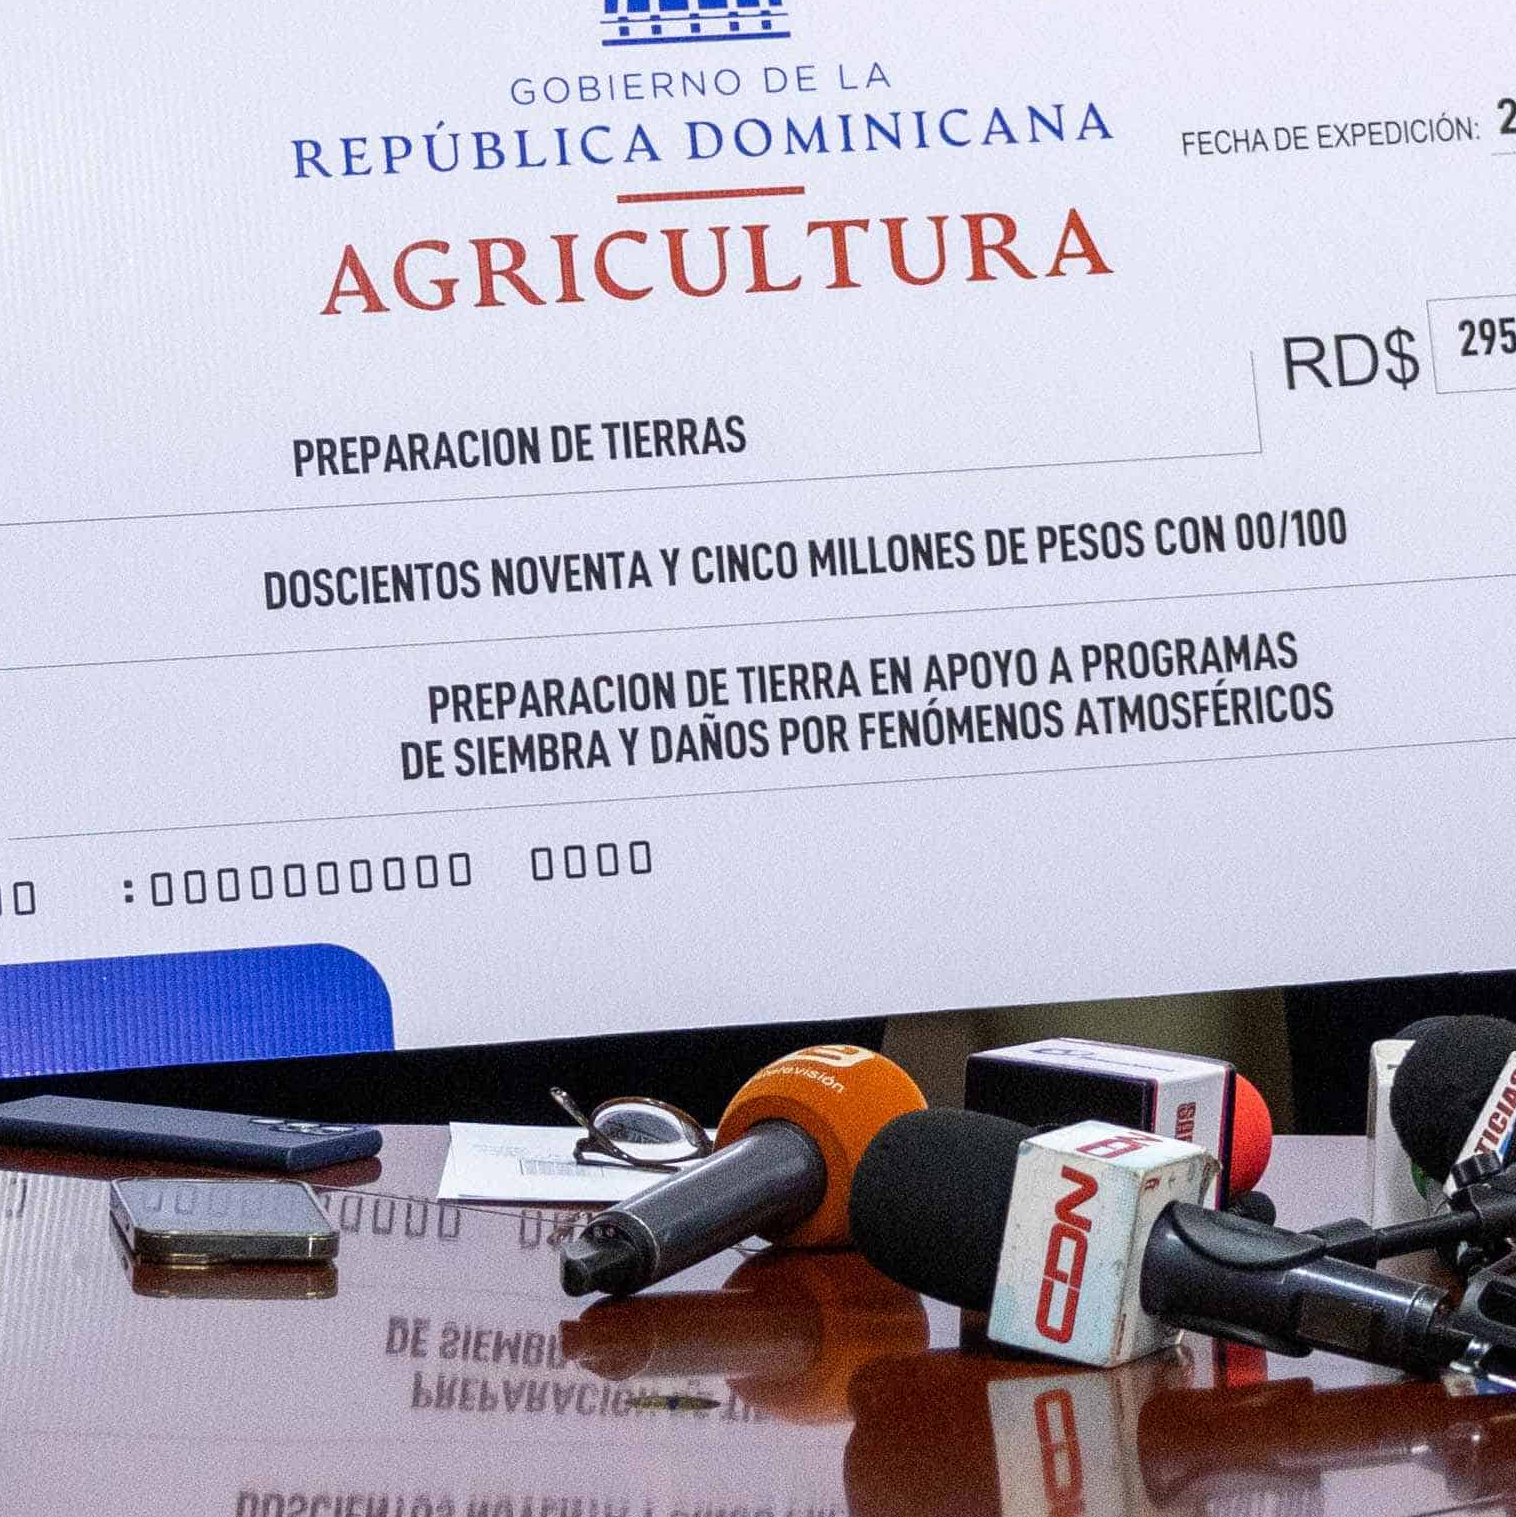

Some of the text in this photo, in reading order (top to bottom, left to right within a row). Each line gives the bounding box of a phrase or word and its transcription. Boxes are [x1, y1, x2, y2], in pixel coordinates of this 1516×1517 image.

[510, 62, 890, 105] GOBIERNO DE LA
[292, 102, 1113, 179] REPÚBLICA DOMINICANA
[1182, 113, 1480, 156] FECHA DE EXPEDICIÓN:
[321, 207, 1114, 315] AGRICULTURA
[1283, 326, 1420, 391] RD$
[293, 415, 747, 477] PREPARACION DE TIERRAS
[264, 506, 1347, 610] DOSCIENTOS NOVENTA Y CINCO MILLONES DE PESOS CON 00/100
[428, 631, 1298, 724] PREPARACION DE TIERRA EN APOYO A PROGRAMAS
[400, 678, 1334, 781] DE SIEMBRA Y DAÑOS POR FENÓMENOS ATMOSFÉRICOS
[1034, 1164, 1099, 1345] CDN
